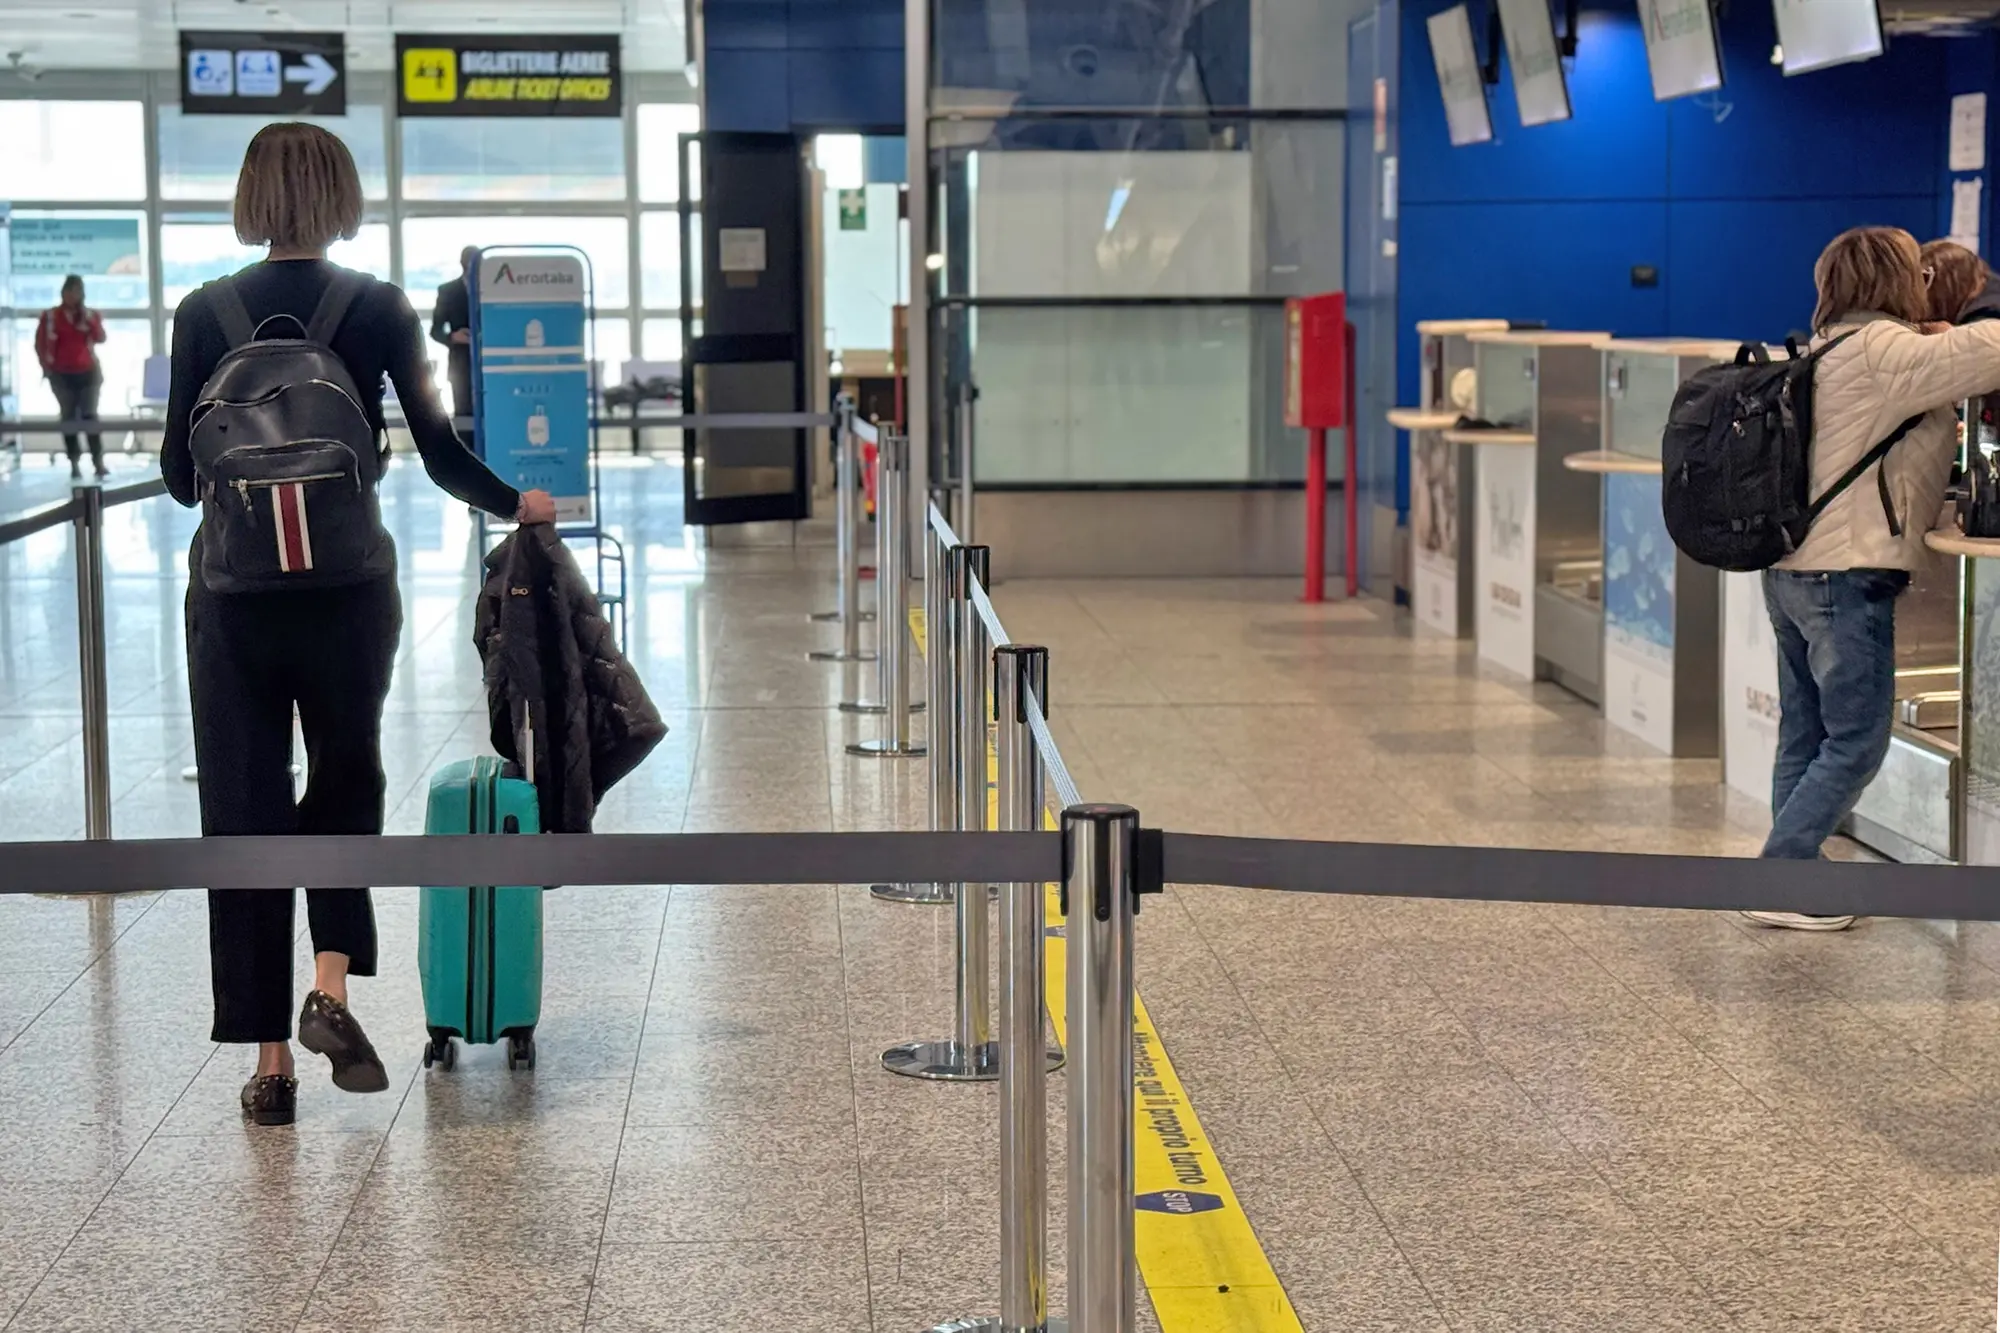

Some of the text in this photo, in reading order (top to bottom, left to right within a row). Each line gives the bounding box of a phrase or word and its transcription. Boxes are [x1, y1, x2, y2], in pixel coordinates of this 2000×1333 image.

[560, 51, 610, 74] AEREE
[1136, 1080, 1176, 1096] qui
[1141, 1107, 1198, 1149] proprio
[1168, 1151, 1208, 1185] turno
[1162, 1191, 1194, 1213] STOP
